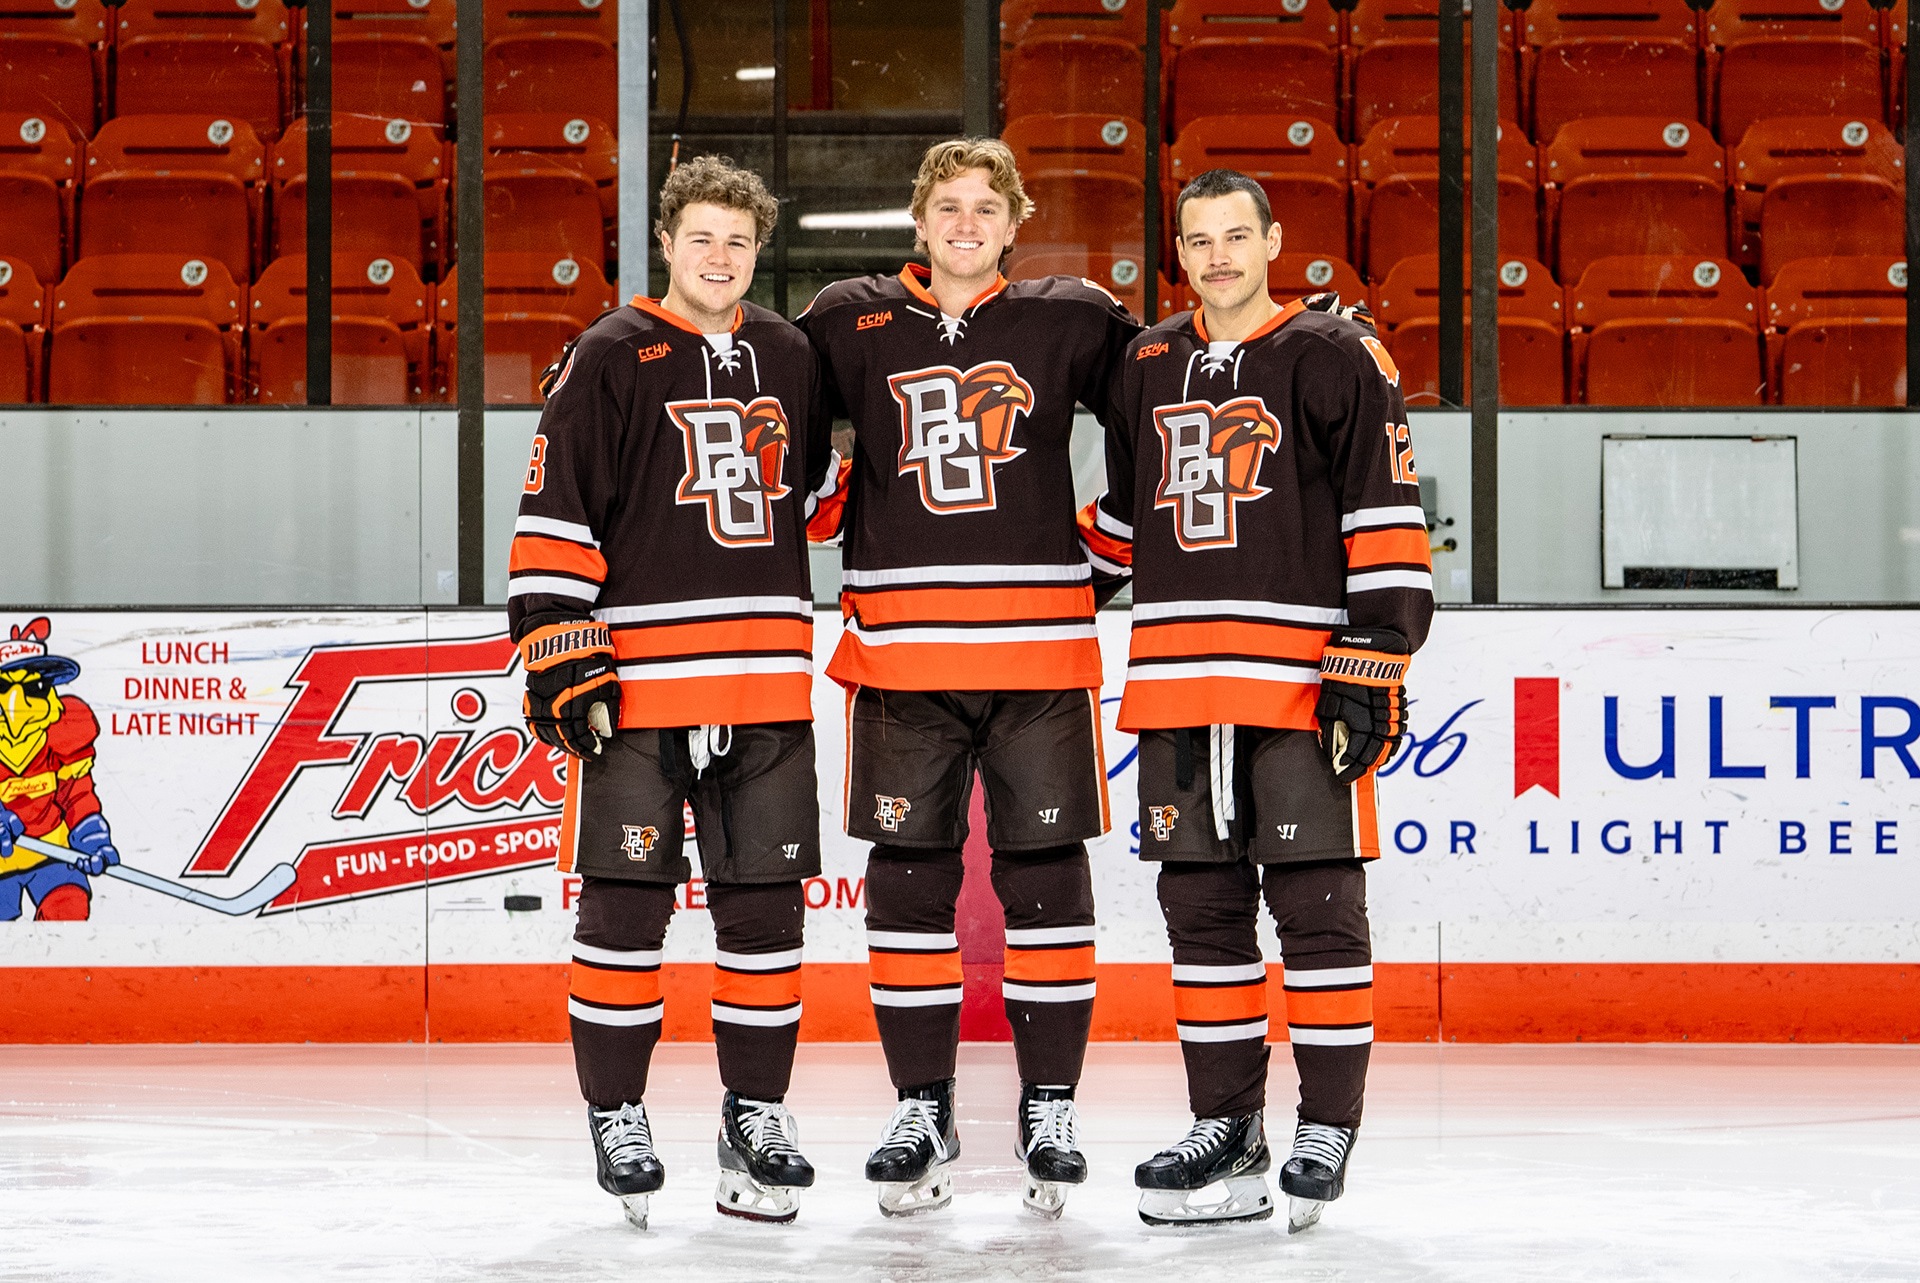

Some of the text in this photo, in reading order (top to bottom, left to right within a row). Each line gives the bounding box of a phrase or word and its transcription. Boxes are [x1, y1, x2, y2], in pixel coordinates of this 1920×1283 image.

[857, 310, 893, 330] CCHA
[638, 342, 672, 362] CCHA
[1136, 342, 1170, 360] CCHA
[1385, 422, 1419, 486] 12
[142, 642, 229, 664] LUNCH
[584, 666, 607, 678] COVERT
[124, 677, 247, 700] DINNER &
[112, 713, 260, 735] LATE NIGHT
[1603, 695, 1920, 781] ULTR
[1530, 819, 1898, 854] LIGHT BEE
[336, 850, 387, 878] FUN
[405, 838, 476, 868] FOOD
